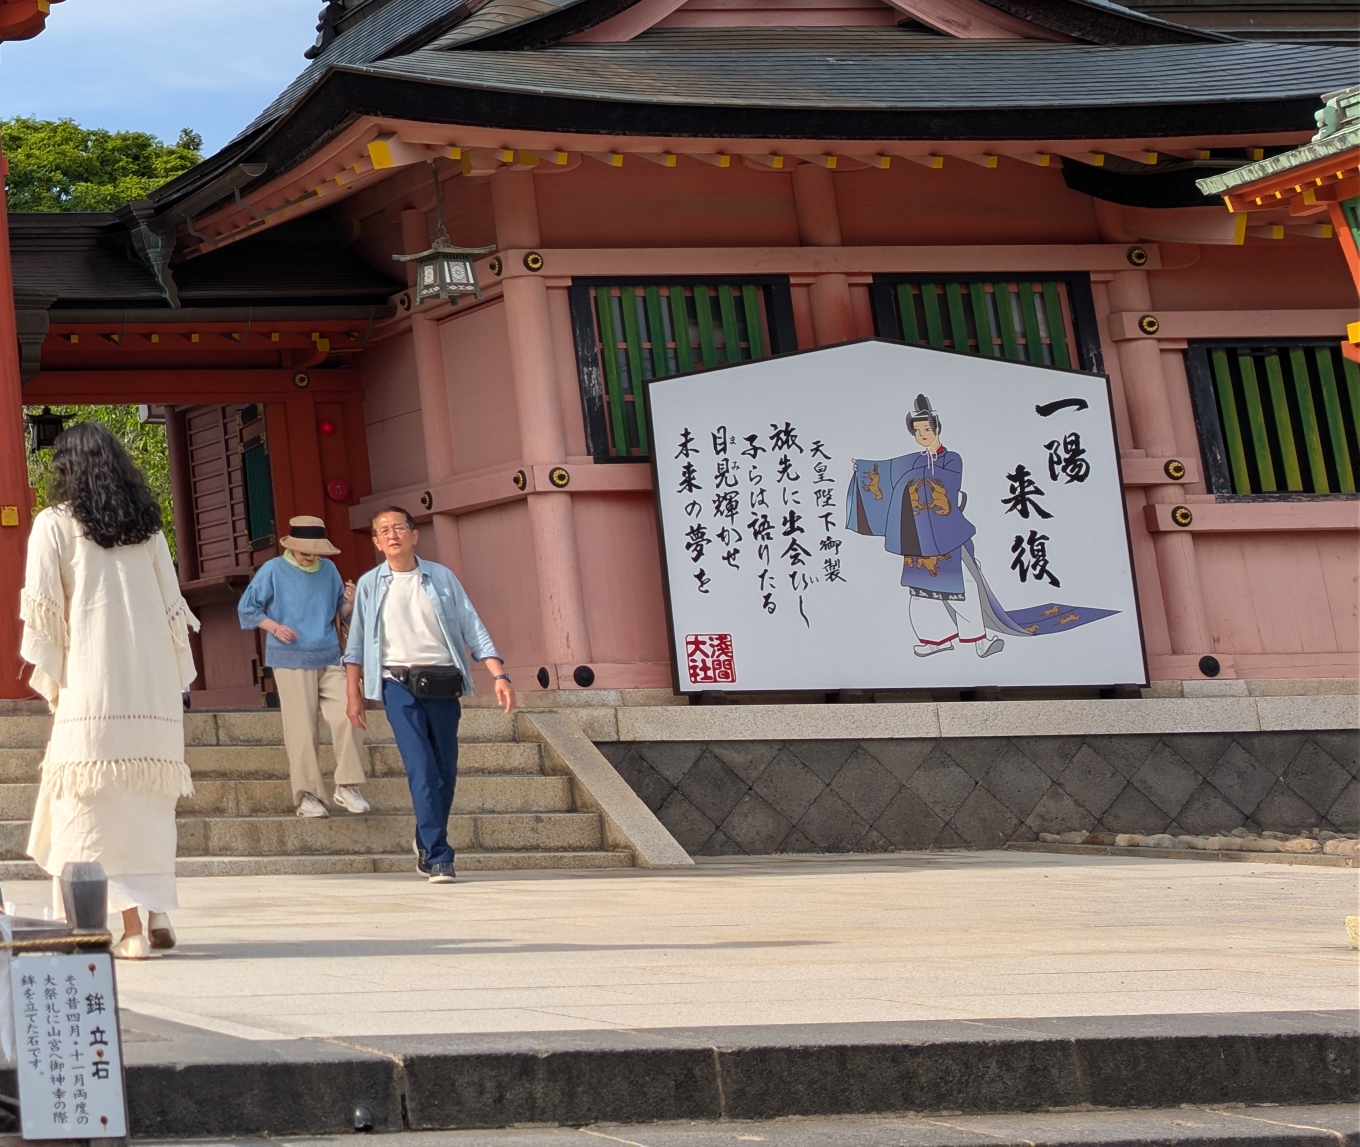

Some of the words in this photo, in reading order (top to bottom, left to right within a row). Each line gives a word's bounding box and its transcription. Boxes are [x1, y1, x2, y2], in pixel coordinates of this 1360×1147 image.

[674, 427, 712, 594] 未来の夢を
[741, 434, 777, 615] 子らは語りたる
[810, 440, 847, 583] 天皇陛下御製
[20, 974, 45, 1077] 鉾を立てた石です。
[44, 974, 70, 1124] 大祭礼に山宮へ御神幸の際
[85, 992, 110, 1080] 鉾立石
